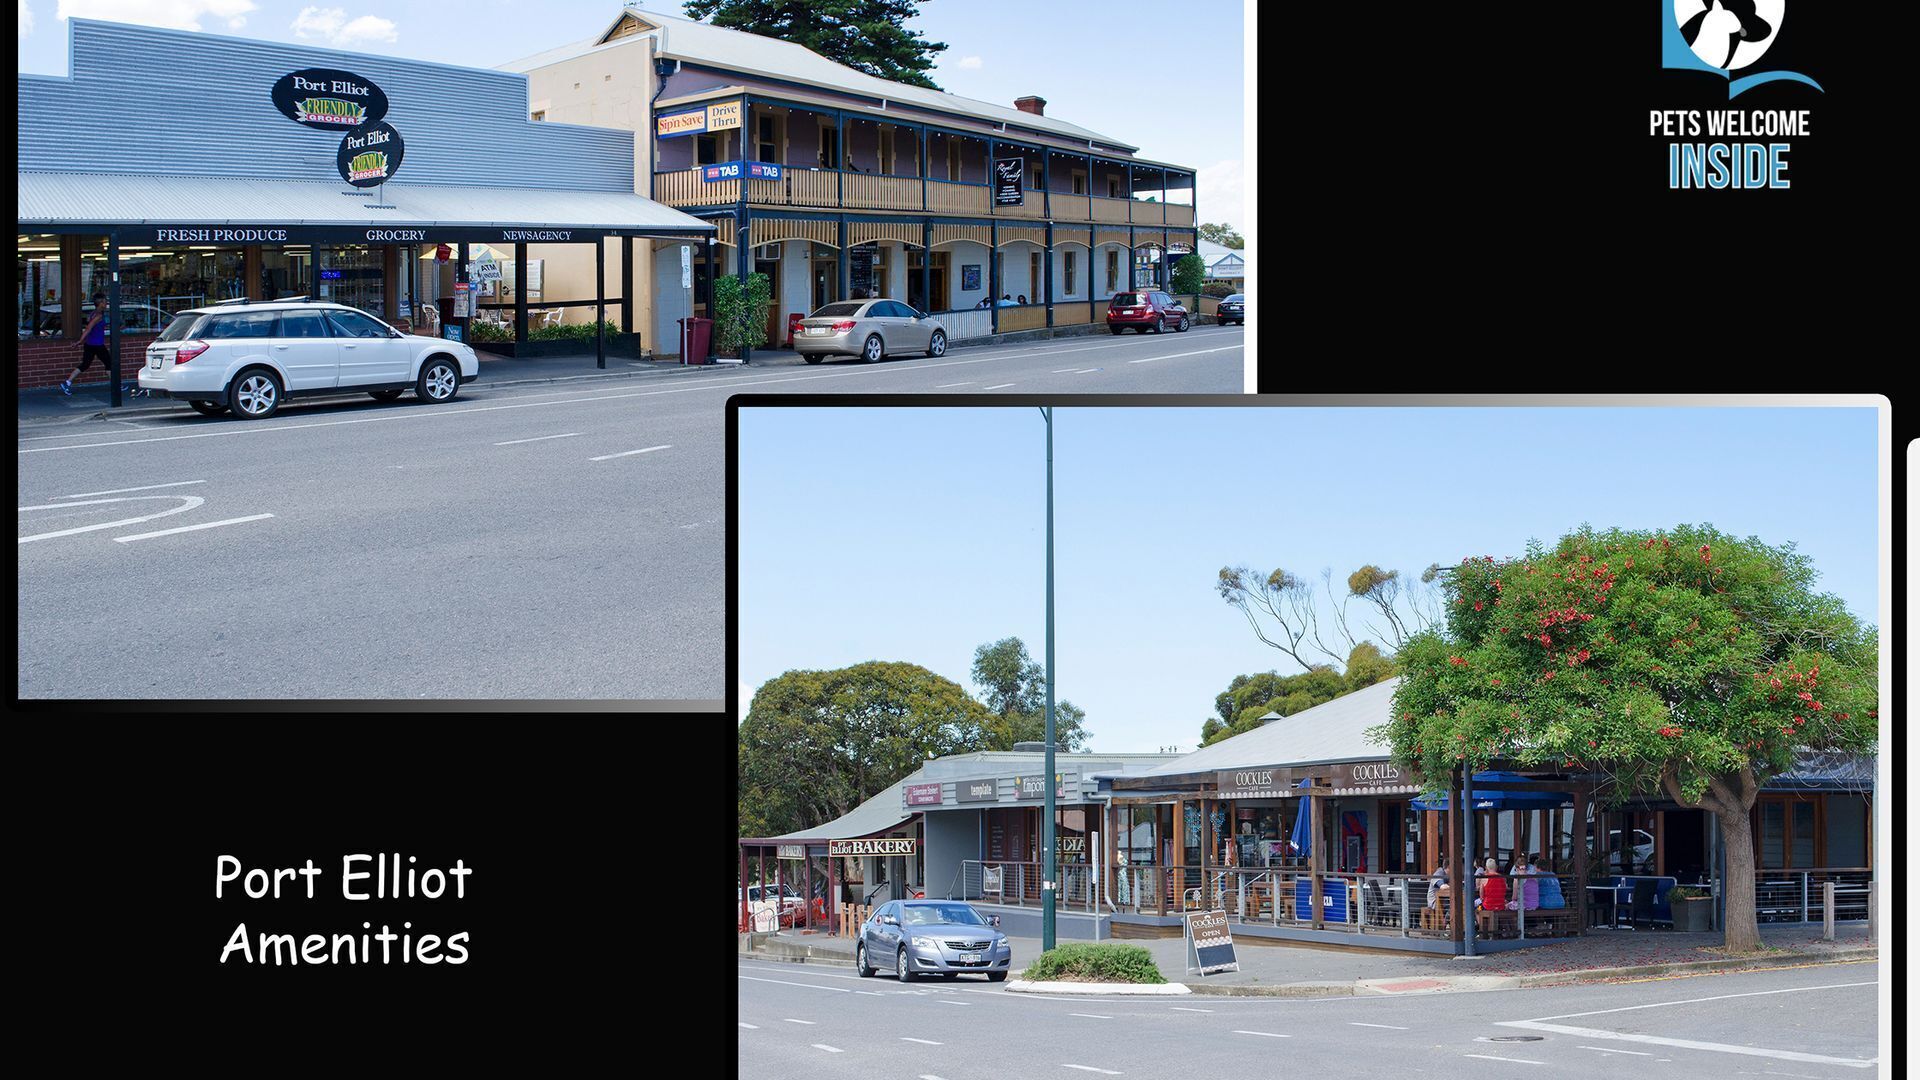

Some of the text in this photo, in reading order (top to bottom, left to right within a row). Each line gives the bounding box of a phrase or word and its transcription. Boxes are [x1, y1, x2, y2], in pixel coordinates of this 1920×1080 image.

[293, 76, 370, 96] Port Elliot
[306, 98, 357, 118] FRIENDLY
[712, 105, 737, 117] Drive
[309, 114, 356, 124] GROCER
[682, 116, 703, 127] Save
[712, 117, 737, 128] Thru
[347, 131, 390, 150] Port Elliot
[353, 153, 384, 172] FRIENDLY
[997, 161, 1016, 175] Royal
[354, 169, 381, 179] GROCER
[720, 165, 739, 177] TAB
[762, 166, 778, 177] TAB
[157, 229, 287, 241] FRESH PRODUCE
[366, 229, 426, 241] GROCERY
[503, 230, 572, 241] NEWSAGENCY
[1353, 764, 1399, 780] COCKLES
[1236, 771, 1272, 786] COCKLES
[971, 783, 992, 797] template
[852, 841, 914, 854] BAKERY
[1192, 916, 1225, 928] COCKLES
[1202, 929, 1221, 937] OPEN
